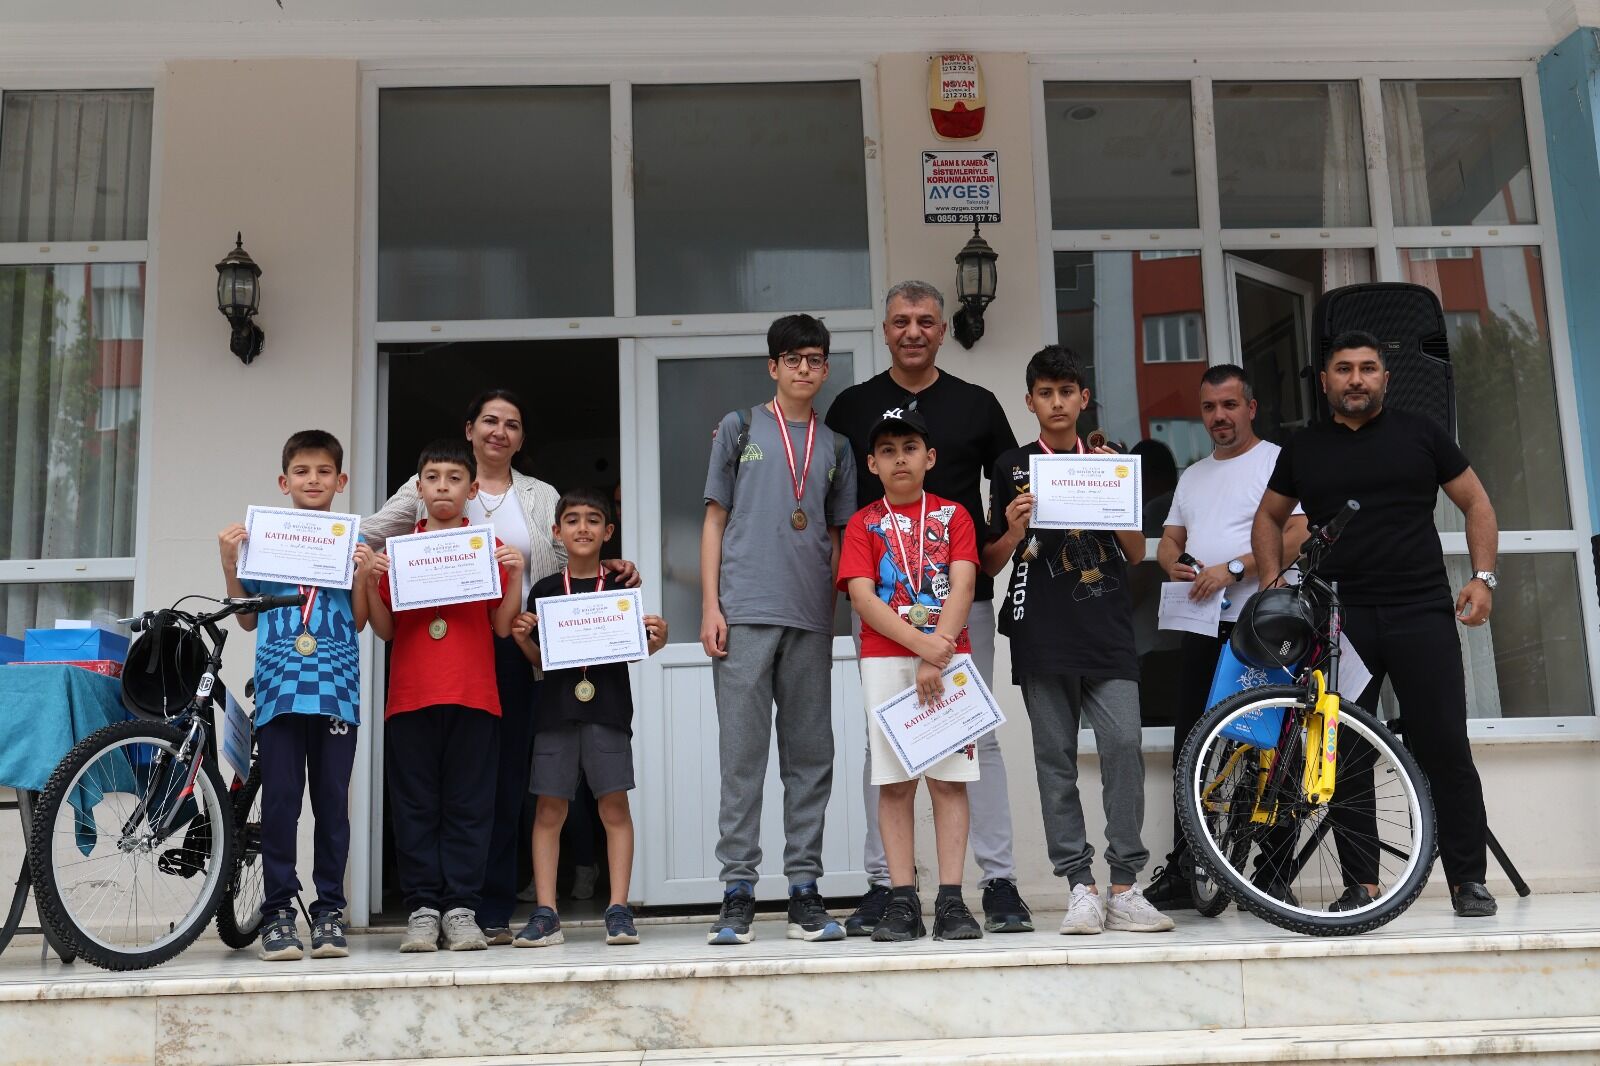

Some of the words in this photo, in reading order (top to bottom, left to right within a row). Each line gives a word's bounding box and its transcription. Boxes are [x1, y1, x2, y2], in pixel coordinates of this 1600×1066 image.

[942, 54, 973, 64] NOYAN
[943, 80, 975, 90] NOYAN
[932, 159, 955, 167] ALARM
[955, 159, 960, 167] &
[961, 159, 989, 167] KAMERA
[932, 167, 989, 175] SİSTEMLERİYLE
[926, 175, 995, 183] KORUNMAKTADIR
[929, 185, 990, 199] AYGES
[937, 214, 957, 222] 0850
[958, 214, 974, 222] 259
[975, 214, 986, 222] 37
[987, 214, 998, 222] 76
[1051, 479, 1086, 487] KATILIM
[1087, 479, 1121, 488] BELGESİ
[264, 531, 300, 542] KATILIM
[301, 535, 336, 545] BELGESİ
[408, 556, 442, 567] KATILIM
[444, 552, 477, 563] BELGESİ
[558, 617, 591, 628] KATILIM
[592, 613, 624, 624] BELGESİ
[904, 705, 936, 729] KATILIM
[936, 689, 967, 711] BELGESİ
